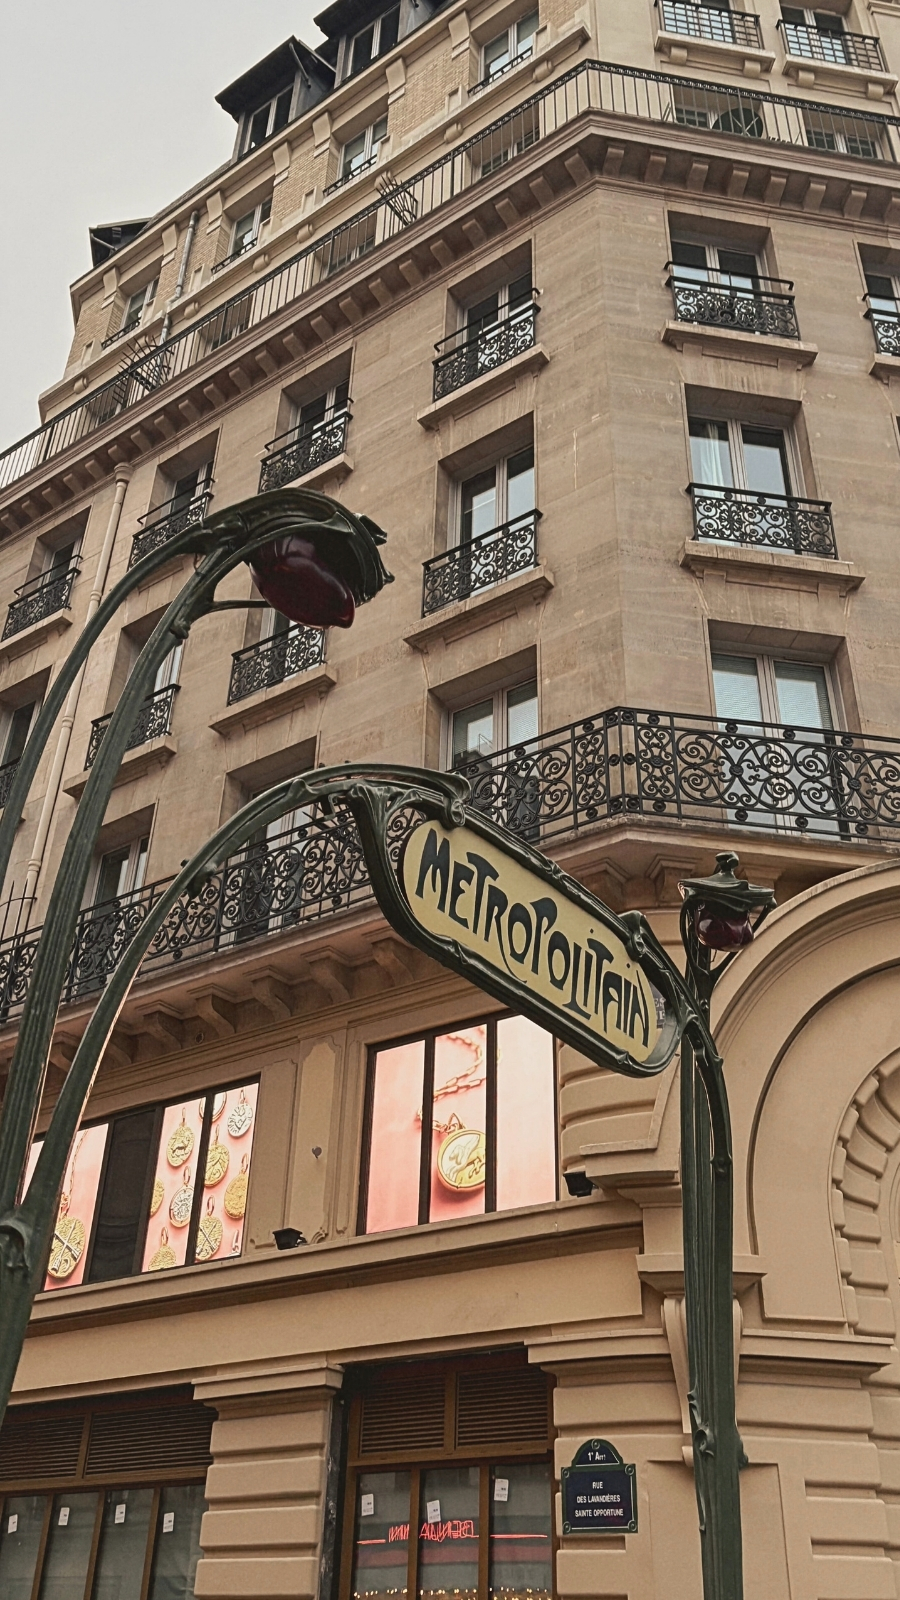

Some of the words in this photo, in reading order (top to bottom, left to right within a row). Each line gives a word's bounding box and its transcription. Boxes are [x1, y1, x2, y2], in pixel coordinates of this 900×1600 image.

[414, 827, 650, 1048] METROPOLITAIN
[592, 1481, 604, 1489] RUE
[576, 1495, 587, 1504] DES
[574, 1509, 593, 1518] SAINTE
[593, 1508, 624, 1517] OPPORTUNE
